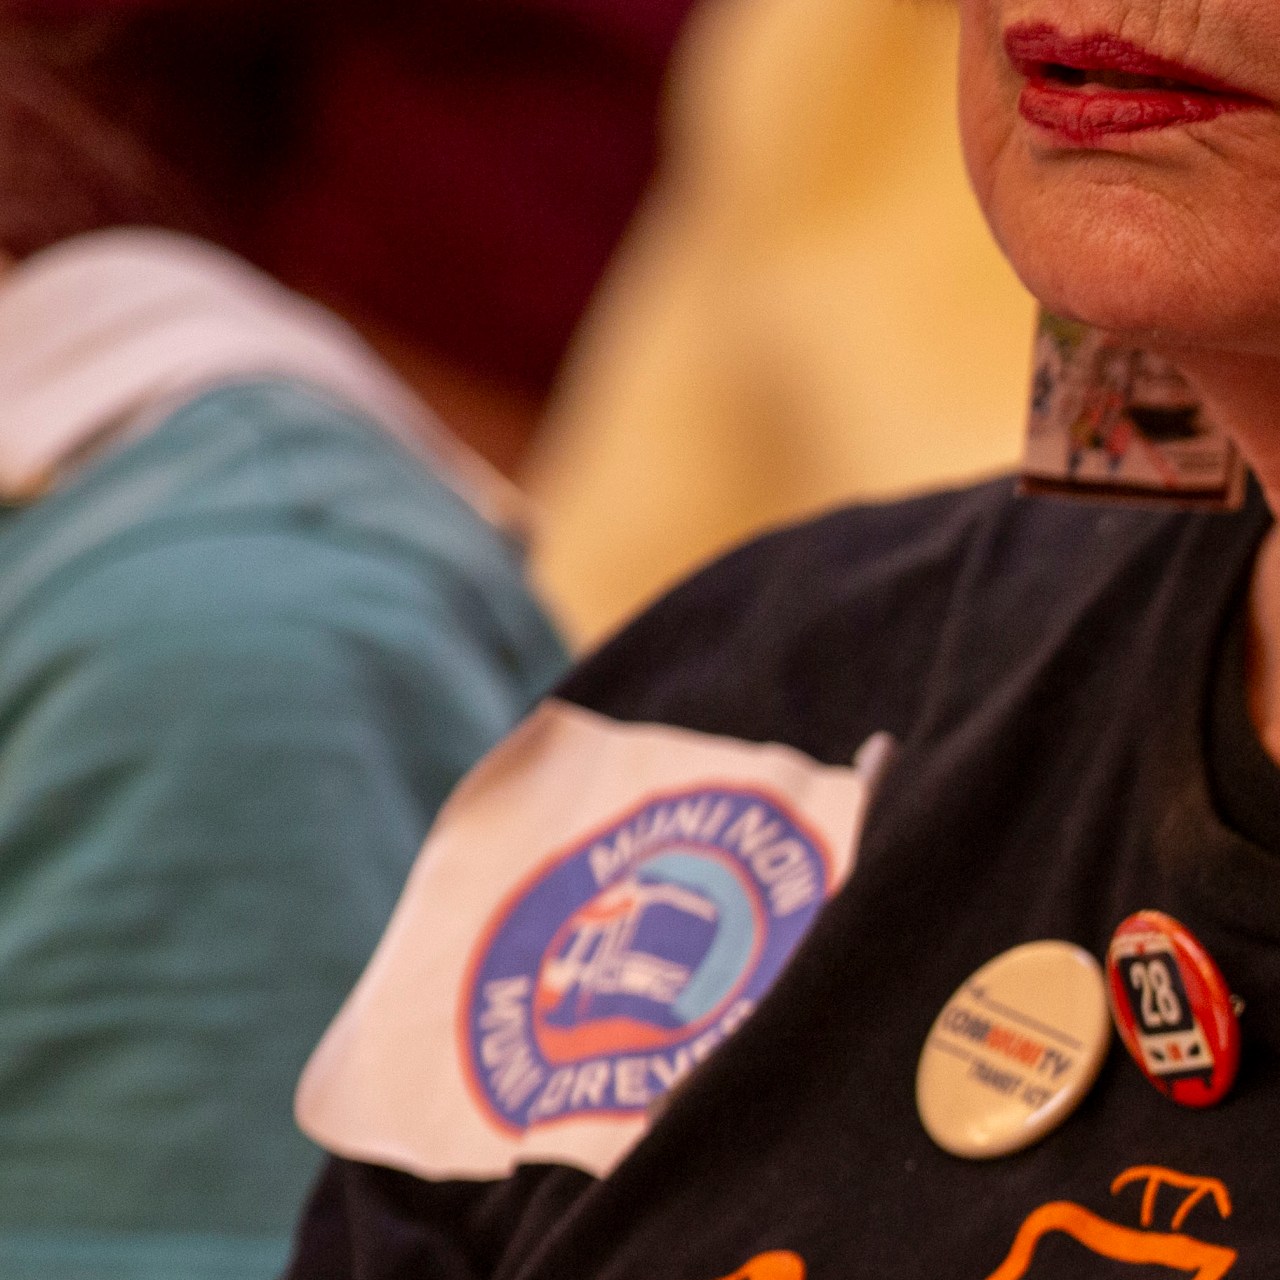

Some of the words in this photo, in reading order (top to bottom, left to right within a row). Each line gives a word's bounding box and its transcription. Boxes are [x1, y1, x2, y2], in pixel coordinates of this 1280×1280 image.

[722, 804, 816, 918] NOW
[479, 974, 542, 1113] MUNI
[1128, 958, 1183, 1029] 28
